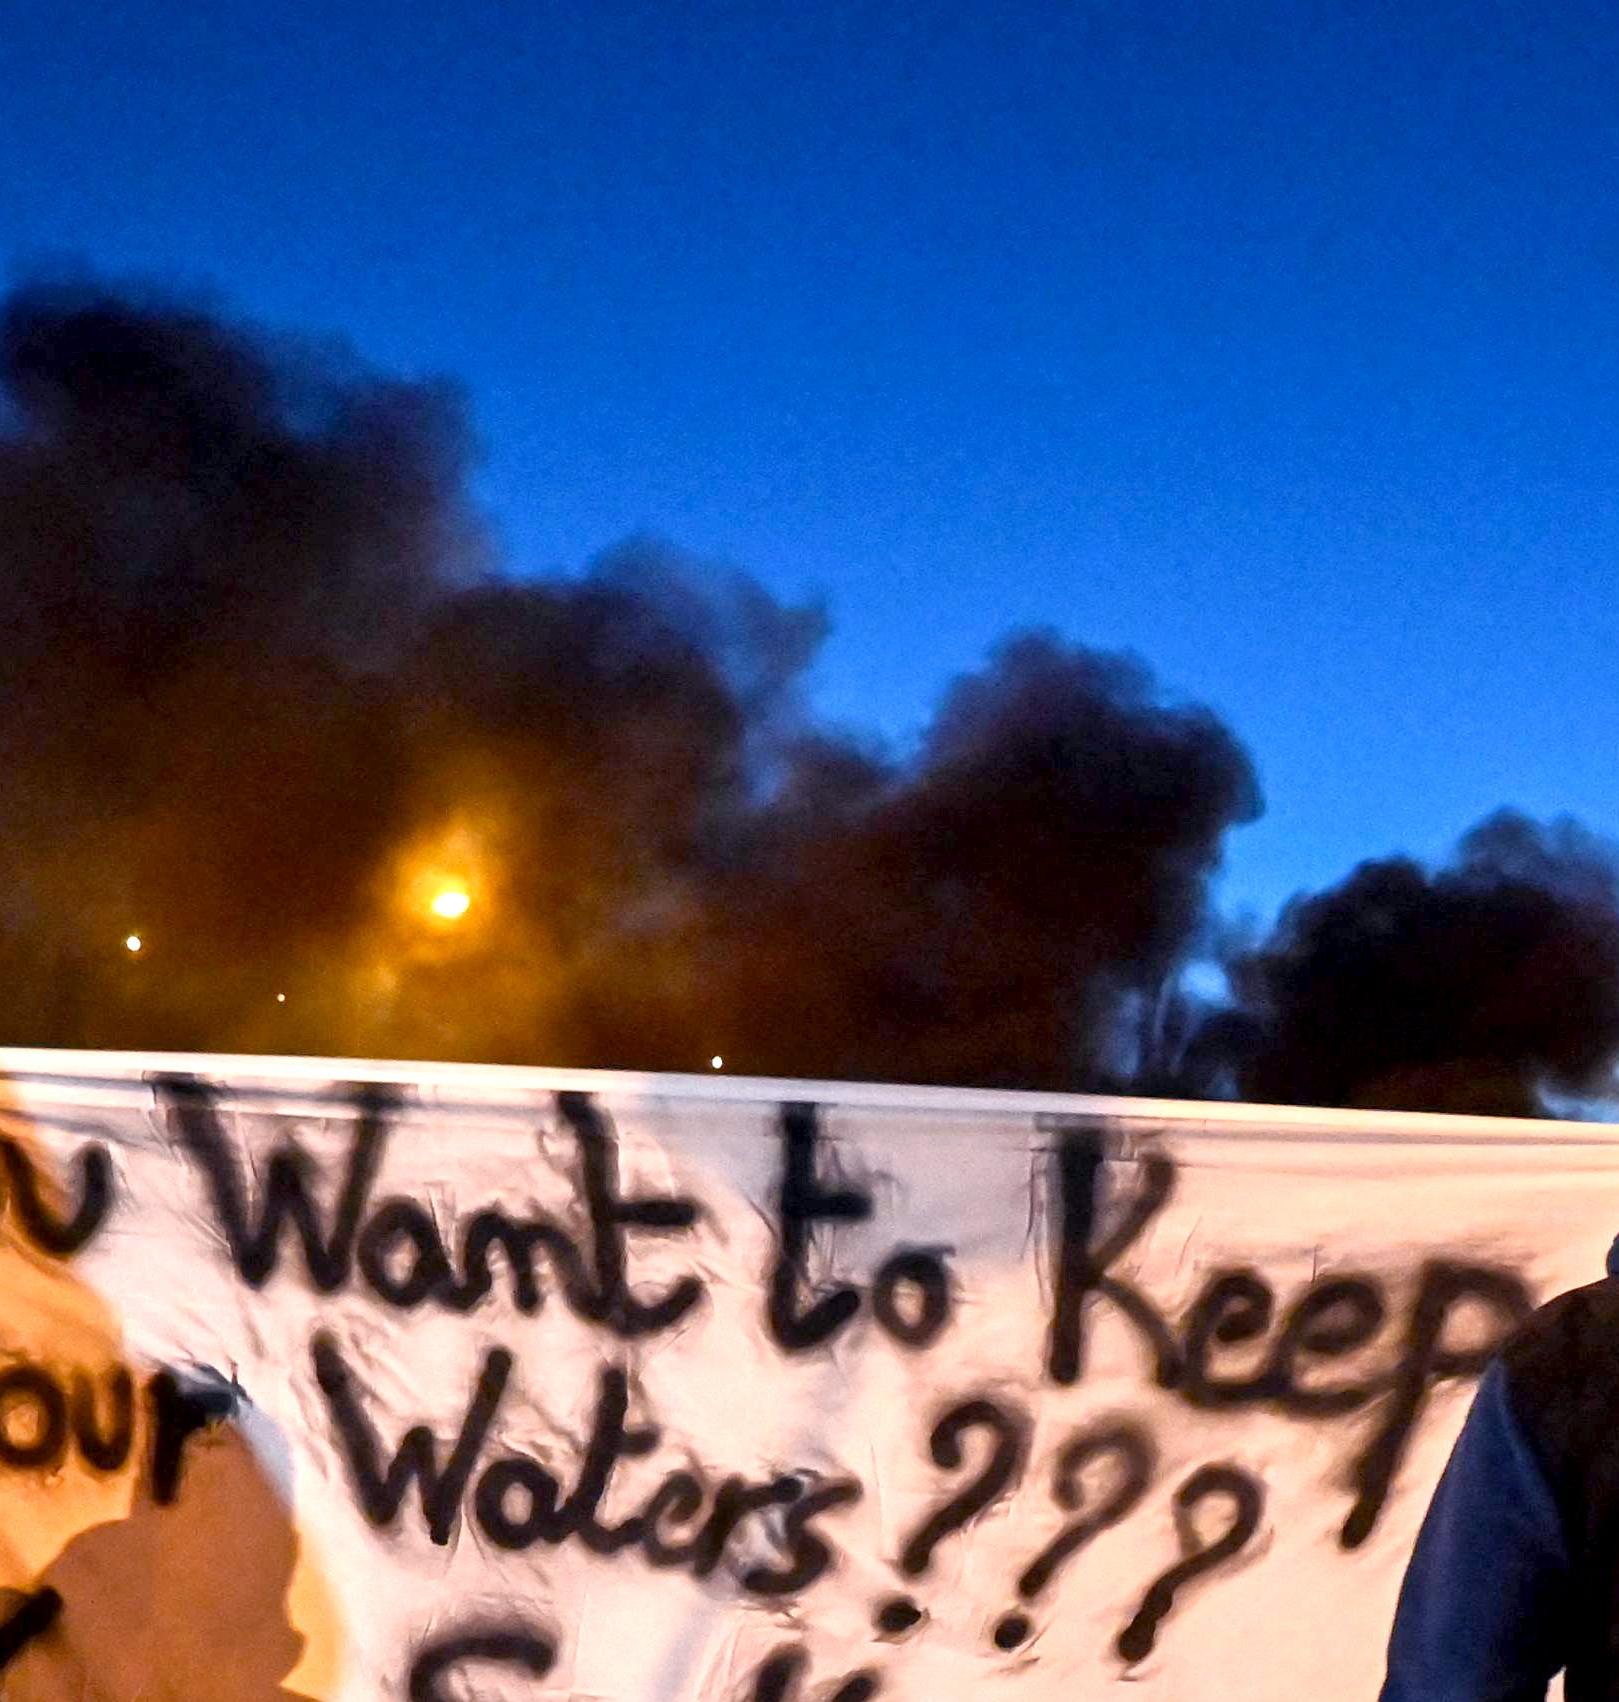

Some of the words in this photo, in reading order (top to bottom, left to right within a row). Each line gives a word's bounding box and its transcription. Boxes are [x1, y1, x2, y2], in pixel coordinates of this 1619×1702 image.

[146, 1070, 706, 1336] Want
[767, 1100, 958, 1352] to
[1034, 1110, 1534, 1552] Keep
